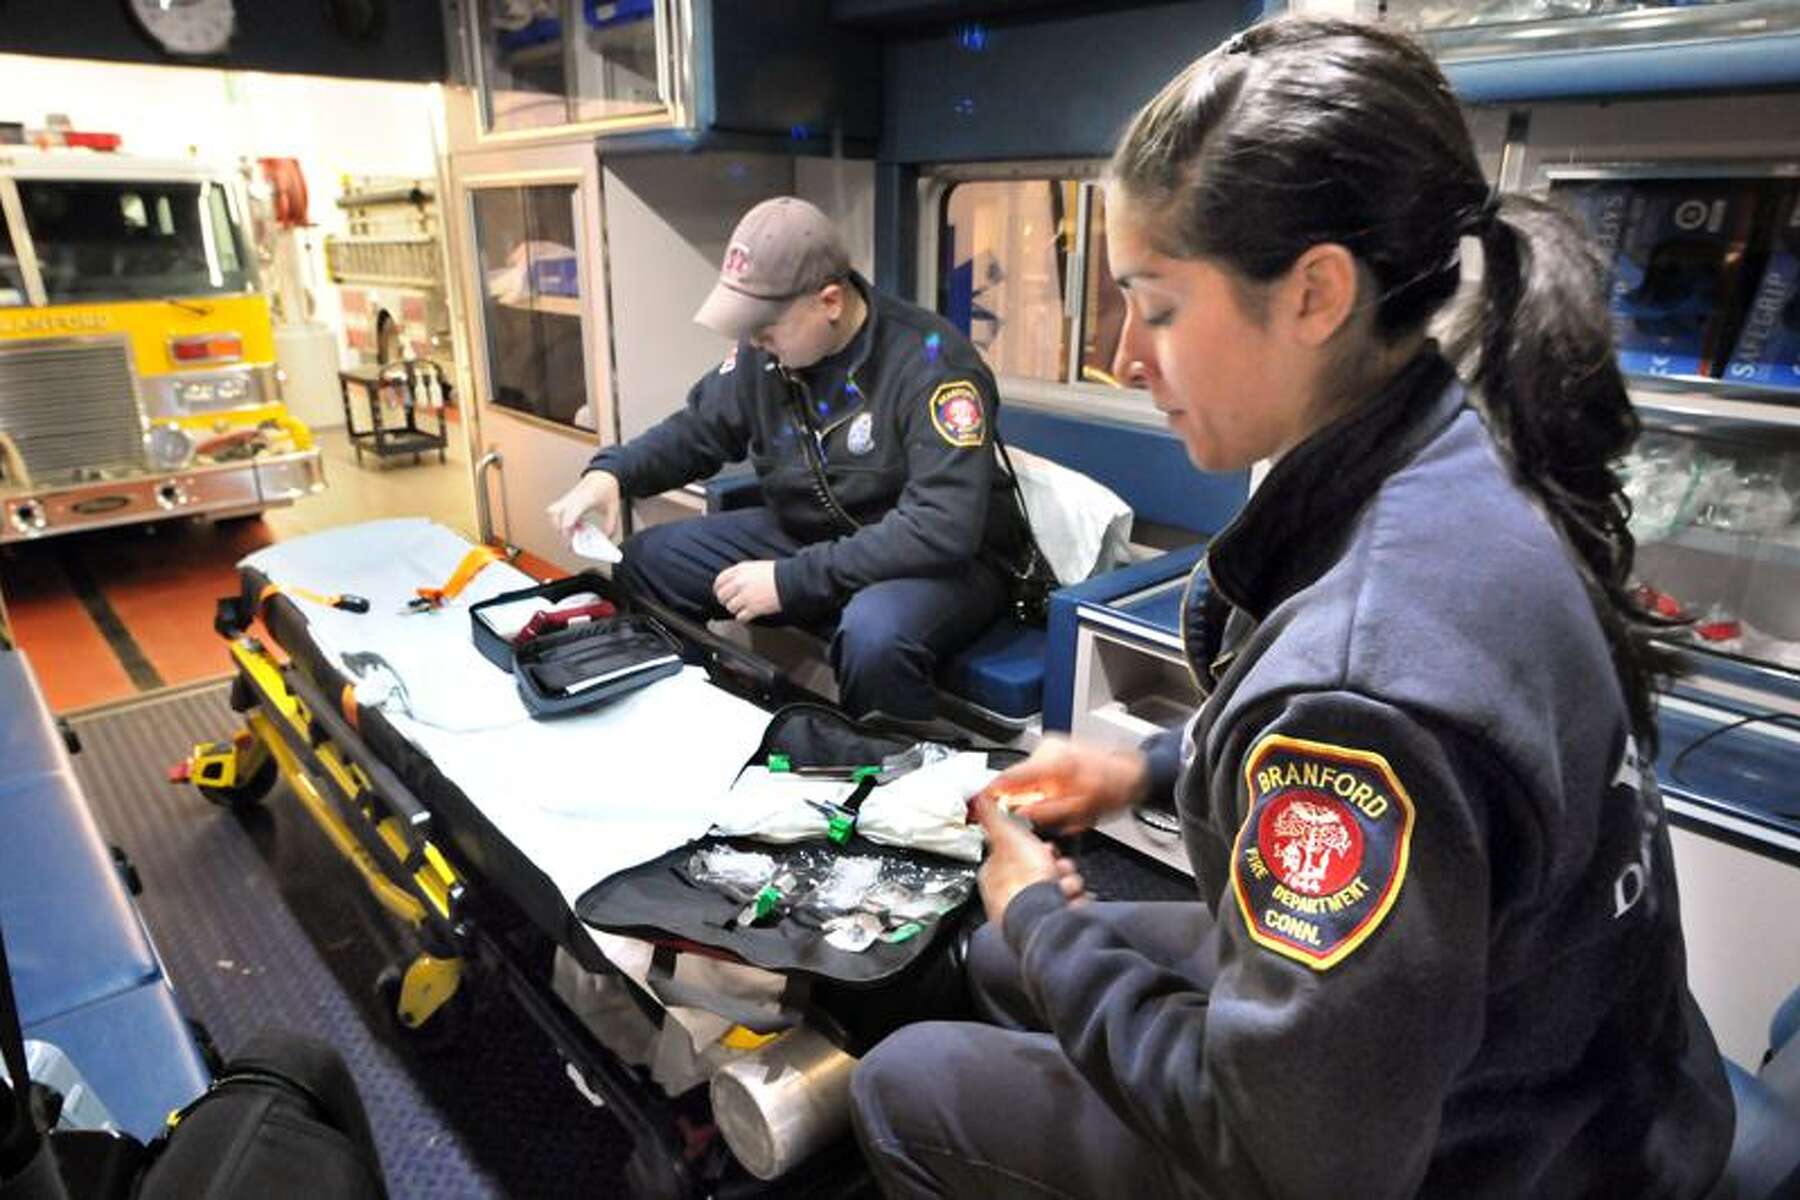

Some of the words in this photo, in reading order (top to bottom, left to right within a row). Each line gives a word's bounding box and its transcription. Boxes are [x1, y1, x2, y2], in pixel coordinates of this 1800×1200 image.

[1258, 762, 1388, 818] BRANFORD
[1245, 847, 1269, 881] FIRE
[1272, 876, 1370, 915] DEPARTMENT
[1264, 909, 1322, 946] CONN.
